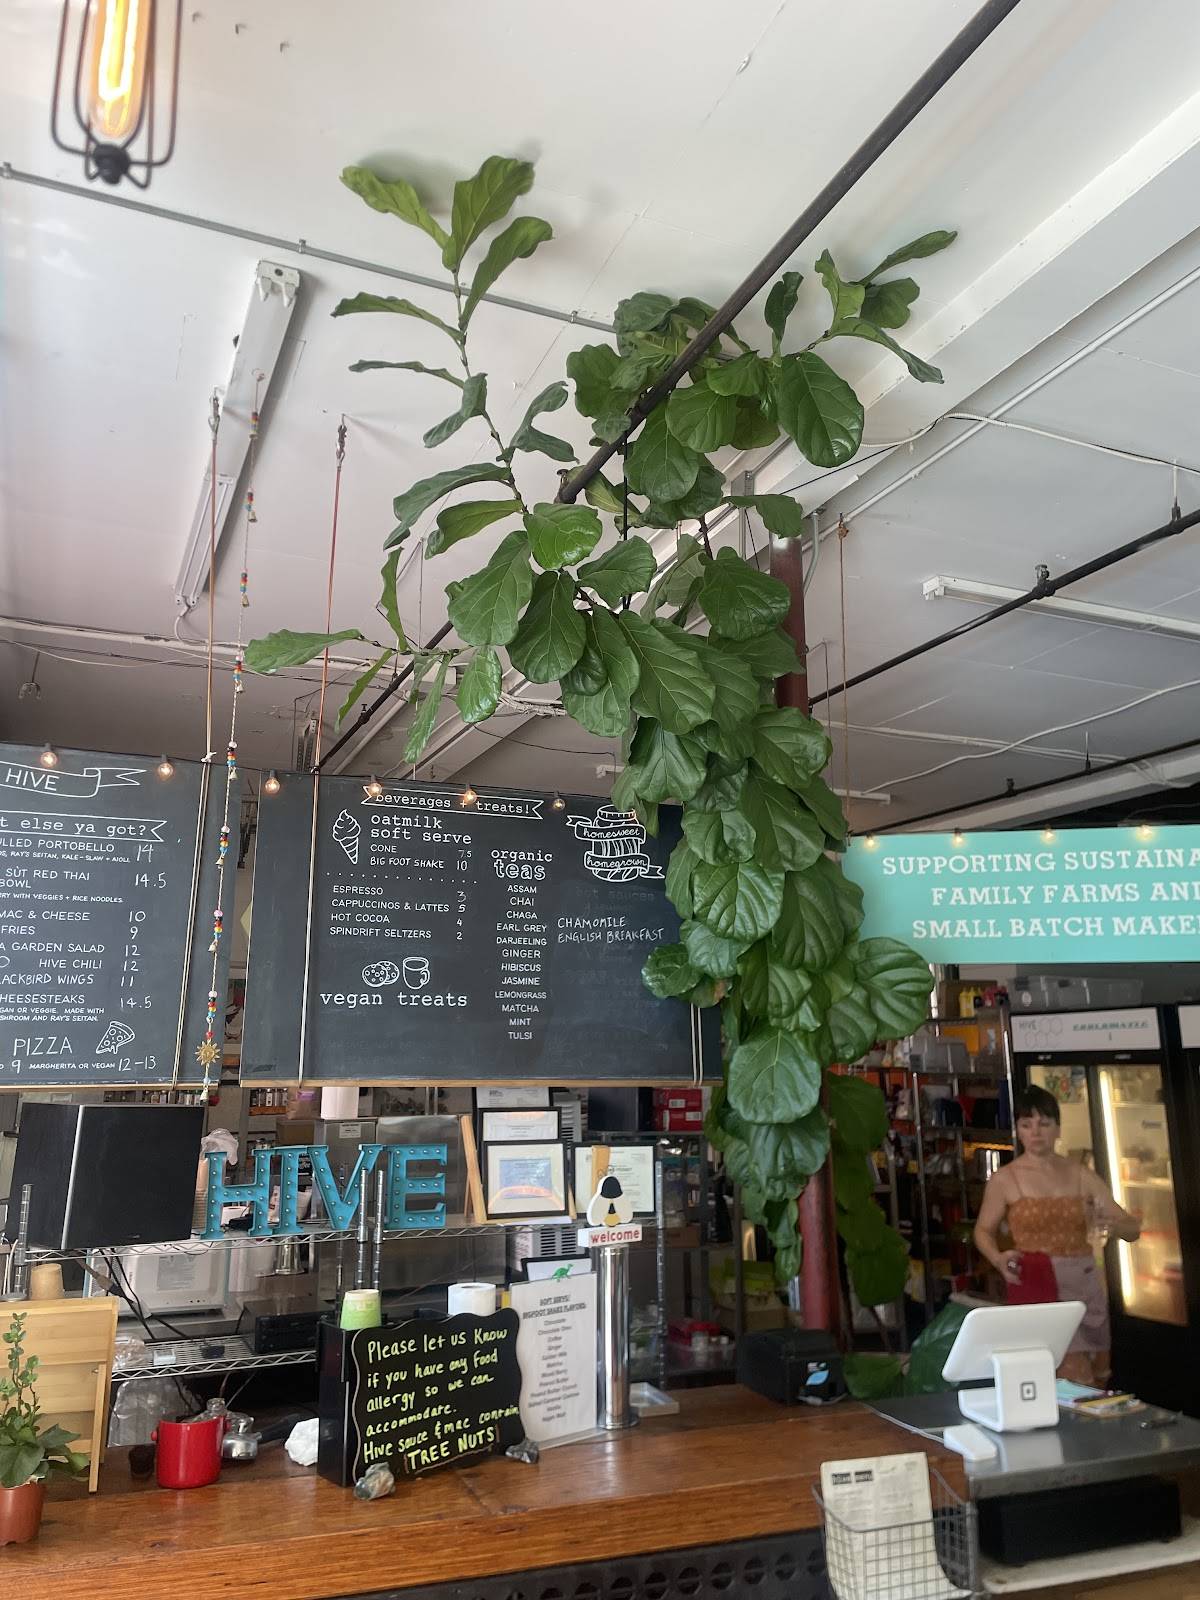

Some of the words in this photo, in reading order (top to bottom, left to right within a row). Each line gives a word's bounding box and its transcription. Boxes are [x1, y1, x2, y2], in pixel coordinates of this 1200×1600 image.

[5, 767, 60, 792] HIVE
[375, 793, 451, 809] beverages
[476, 801, 530, 814] treats!
[20, 818, 64, 831] else
[75, 822, 96, 834] ya
[106, 824, 147, 837] got?
[370, 815, 443, 829] oatmilk
[370, 828, 412, 840] soft
[422, 831, 472, 844] serve
[583, 827, 641, 839] homesweet
[38, 839, 115, 852] PORTOBELLO
[136, 844, 154, 863] 14
[370, 844, 397, 853] CONE
[491, 850, 553, 862] organic
[370, 857, 386, 866] BIG
[388, 857, 411, 867] FOOT
[414, 860, 444, 869] SHAKE
[456, 860, 468, 870] 10
[494, 858, 546, 880] teas
[586, 855, 647, 873] homegrown
[882, 853, 1056, 876] SUPPORTING
[33, 869, 58, 879] RED
[64, 871, 90, 881] THAI
[135, 872, 166, 888] 14.5
[333, 885, 383, 896] ESPRESSO
[507, 884, 537, 894] ASSAM
[931, 886, 1035, 906] FAMILY
[1042, 883, 1140, 904] FARMS
[331, 899, 400, 910] CAPPUCCINOS
[415, 904, 450, 912] LATTES
[458, 904, 466, 913] 5
[509, 897, 535, 906] CHAI
[27, 910, 37, 919] &
[41, 911, 91, 920] CHEESE
[129, 910, 146, 922] 10
[331, 913, 351, 921] HOT
[355, 914, 390, 923] COCOA
[456, 918, 463, 926] 4
[506, 910, 537, 919] CHAGA
[496, 923, 520, 932] EARL
[523, 924, 547, 933] GREY
[557, 916, 627, 929] CHAMOMILE
[912, 919, 1001, 939] SMALL
[1009, 917, 1104, 937] BATCH
[1, 925, 36, 935] FRIES
[129, 926, 139, 940] 9
[330, 927, 381, 937] SPINDRIFT
[384, 929, 432, 938] SELTZERS
[456, 932, 463, 940] 2
[557, 932, 602, 944] ENGLISH
[606, 928, 664, 943] BREAKFAST
[496, 937, 547, 946] DARJEELING
[11, 942, 63, 953] GARDEN
[67, 944, 105, 953] SALAD
[125, 944, 141, 957] 12
[502, 949, 541, 958] GINGER
[39, 959, 67, 969] HIVE
[72, 960, 102, 969] CHILI
[123, 961, 139, 972] 12
[501, 963, 541, 972] HIBISCUS
[0, 973, 52, 985] ACKBIRD
[57, 974, 94, 985] WINGS
[120, 976, 134, 987] 11
[501, 977, 540, 986] JASMINE
[320, 993, 383, 1008] vegan
[397, 992, 467, 1007] treats
[494, 991, 547, 999] LEMONGRASS
[120, 996, 152, 1009] 14.5
[501, 1004, 539, 1013] MATCHA
[509, 1018, 531, 1026] MINT
[508, 1031, 532, 1040] TULSI
[13, 1036, 73, 1057] PIZZA
[11, 1059, 21, 1074] 9
[200, 1143, 448, 1240] HIVE
[590, 1227, 640, 1244] welcome
[367, 1339, 417, 1364] Please
[423, 1334, 446, 1353] let
[367, 1372, 380, 1389] if
[385, 1368, 408, 1390] you
[414, 1363, 445, 1379] have
[449, 1357, 468, 1375] any
[366, 1390, 416, 1413] allergy
[425, 1386, 439, 1397] so
[448, 1379, 464, 1392] we
[470, 1373, 494, 1386] can
[366, 1404, 457, 1437] accommodate.
[363, 1442, 393, 1464] Hive
[398, 1430, 429, 1453] sauce
[443, 1416, 471, 1434] mac
[478, 1405, 520, 1424] contain
[407, 1441, 450, 1470] TREE
[457, 1426, 496, 1453] NUTS
